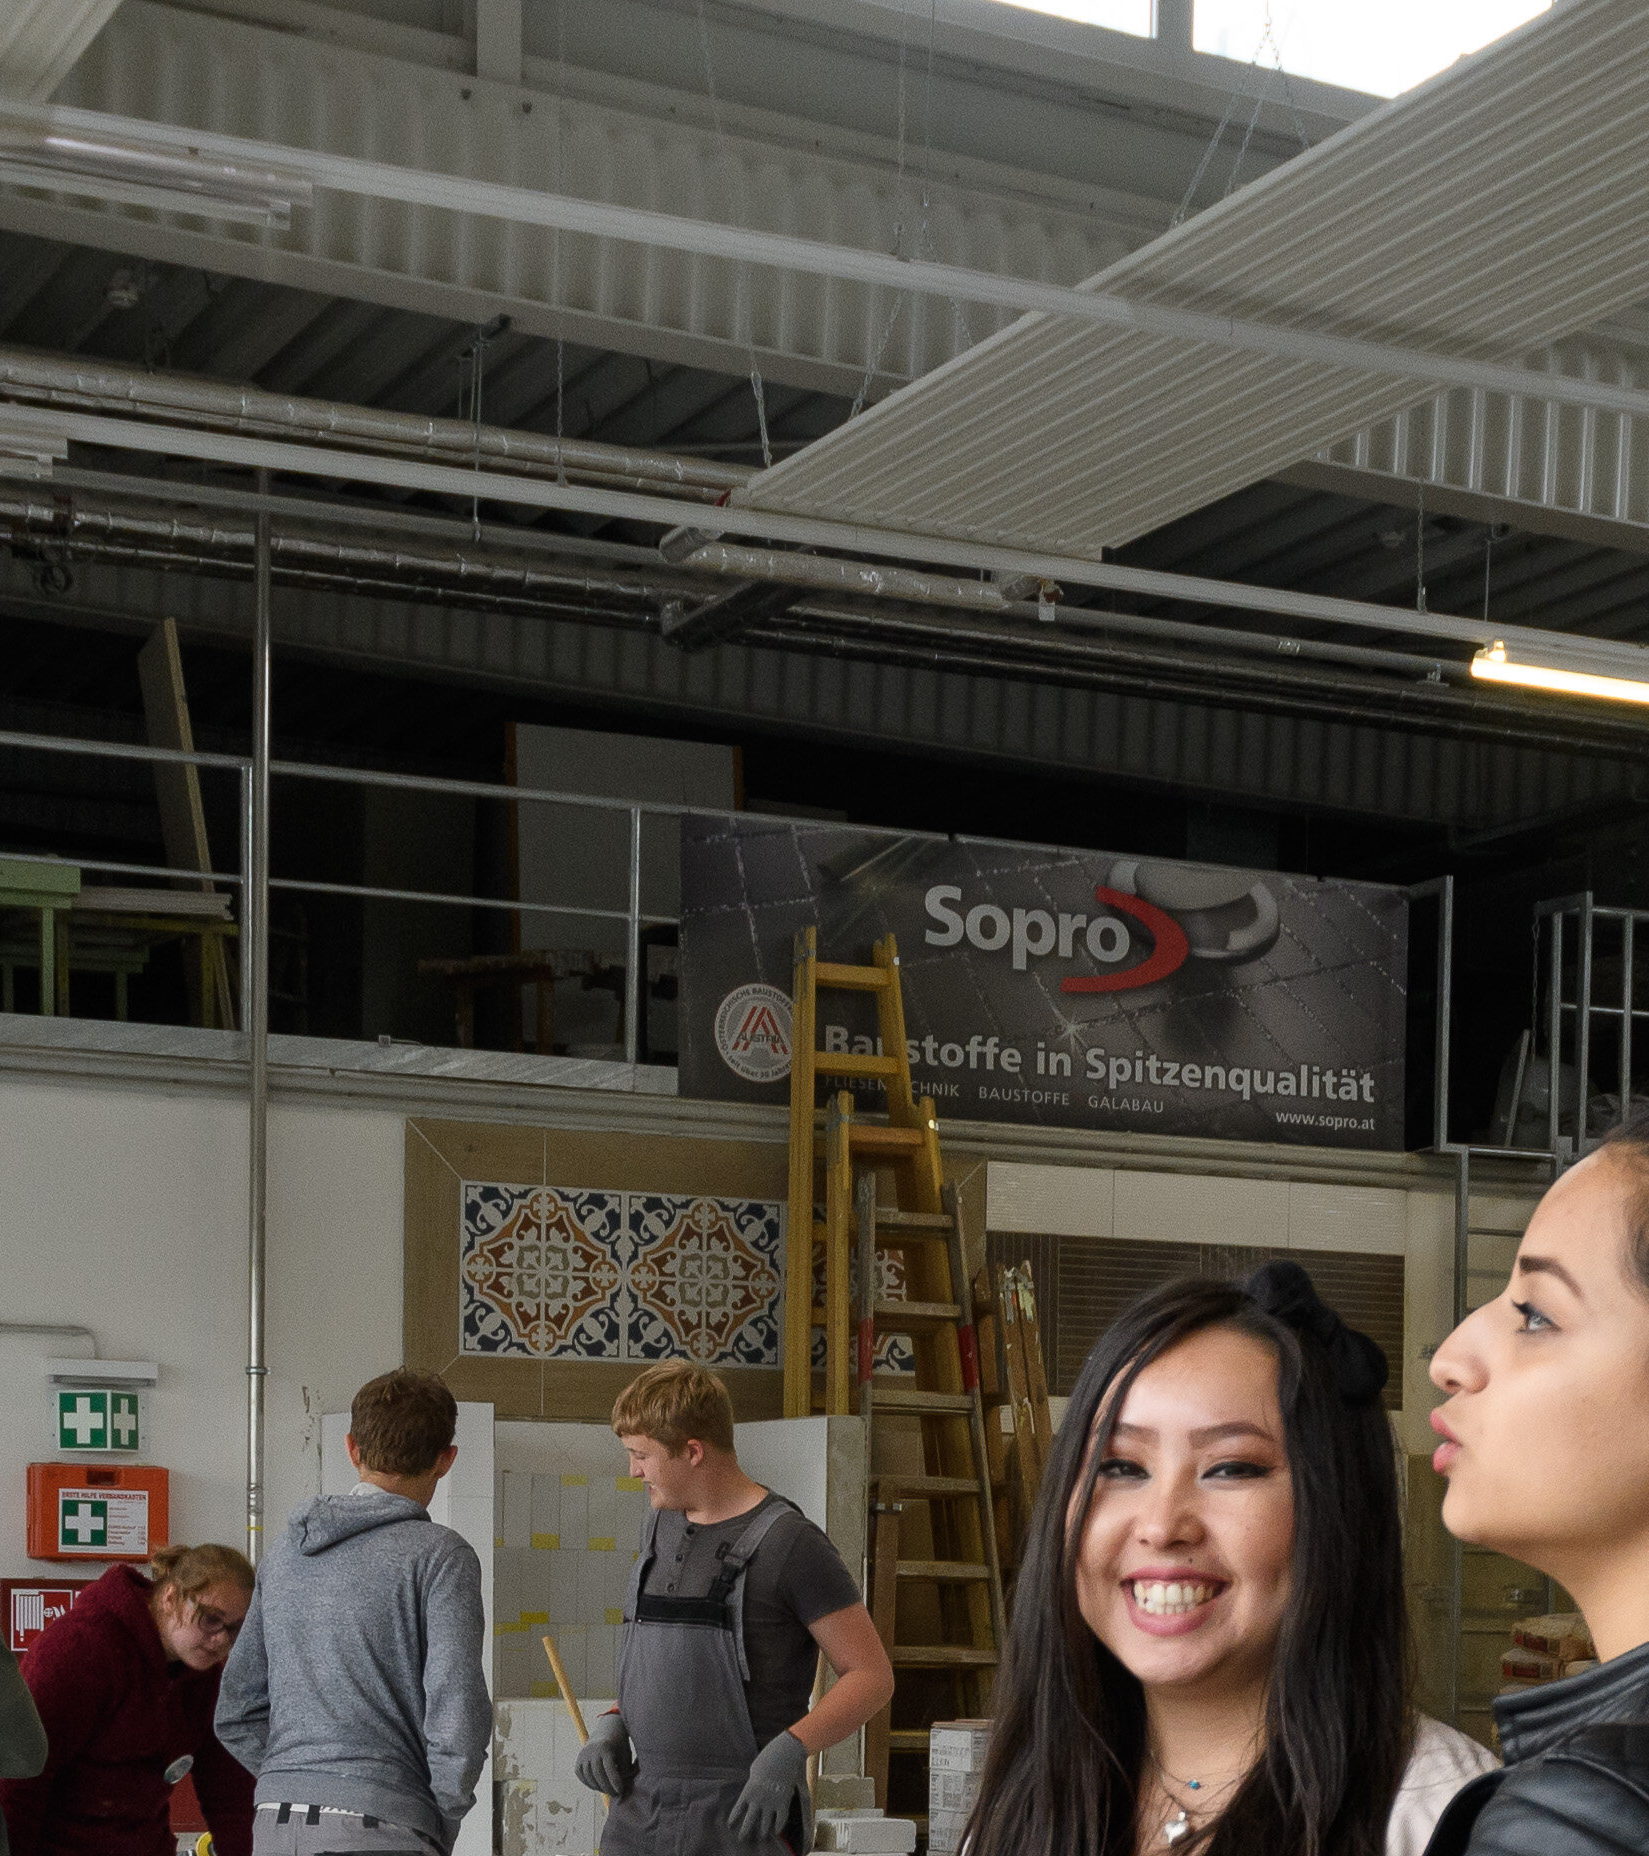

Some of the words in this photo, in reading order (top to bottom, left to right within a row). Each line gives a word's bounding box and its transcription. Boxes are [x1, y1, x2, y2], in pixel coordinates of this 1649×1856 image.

[924, 884, 1130, 971] Sopro
[737, 1031, 784, 1045] AUSTRIA
[1037, 1042, 1072, 1077] in
[1085, 1047, 1375, 1103] Spitzenqualität
[825, 1075, 960, 1097] FLIESENCHNIK
[979, 1086, 1071, 1107] BAUSTOFFE
[1088, 1095, 1165, 1114] GALABAU
[1275, 1111, 1376, 1131] www.sopro.at
[61, 1491, 79, 1499] ERSTE
